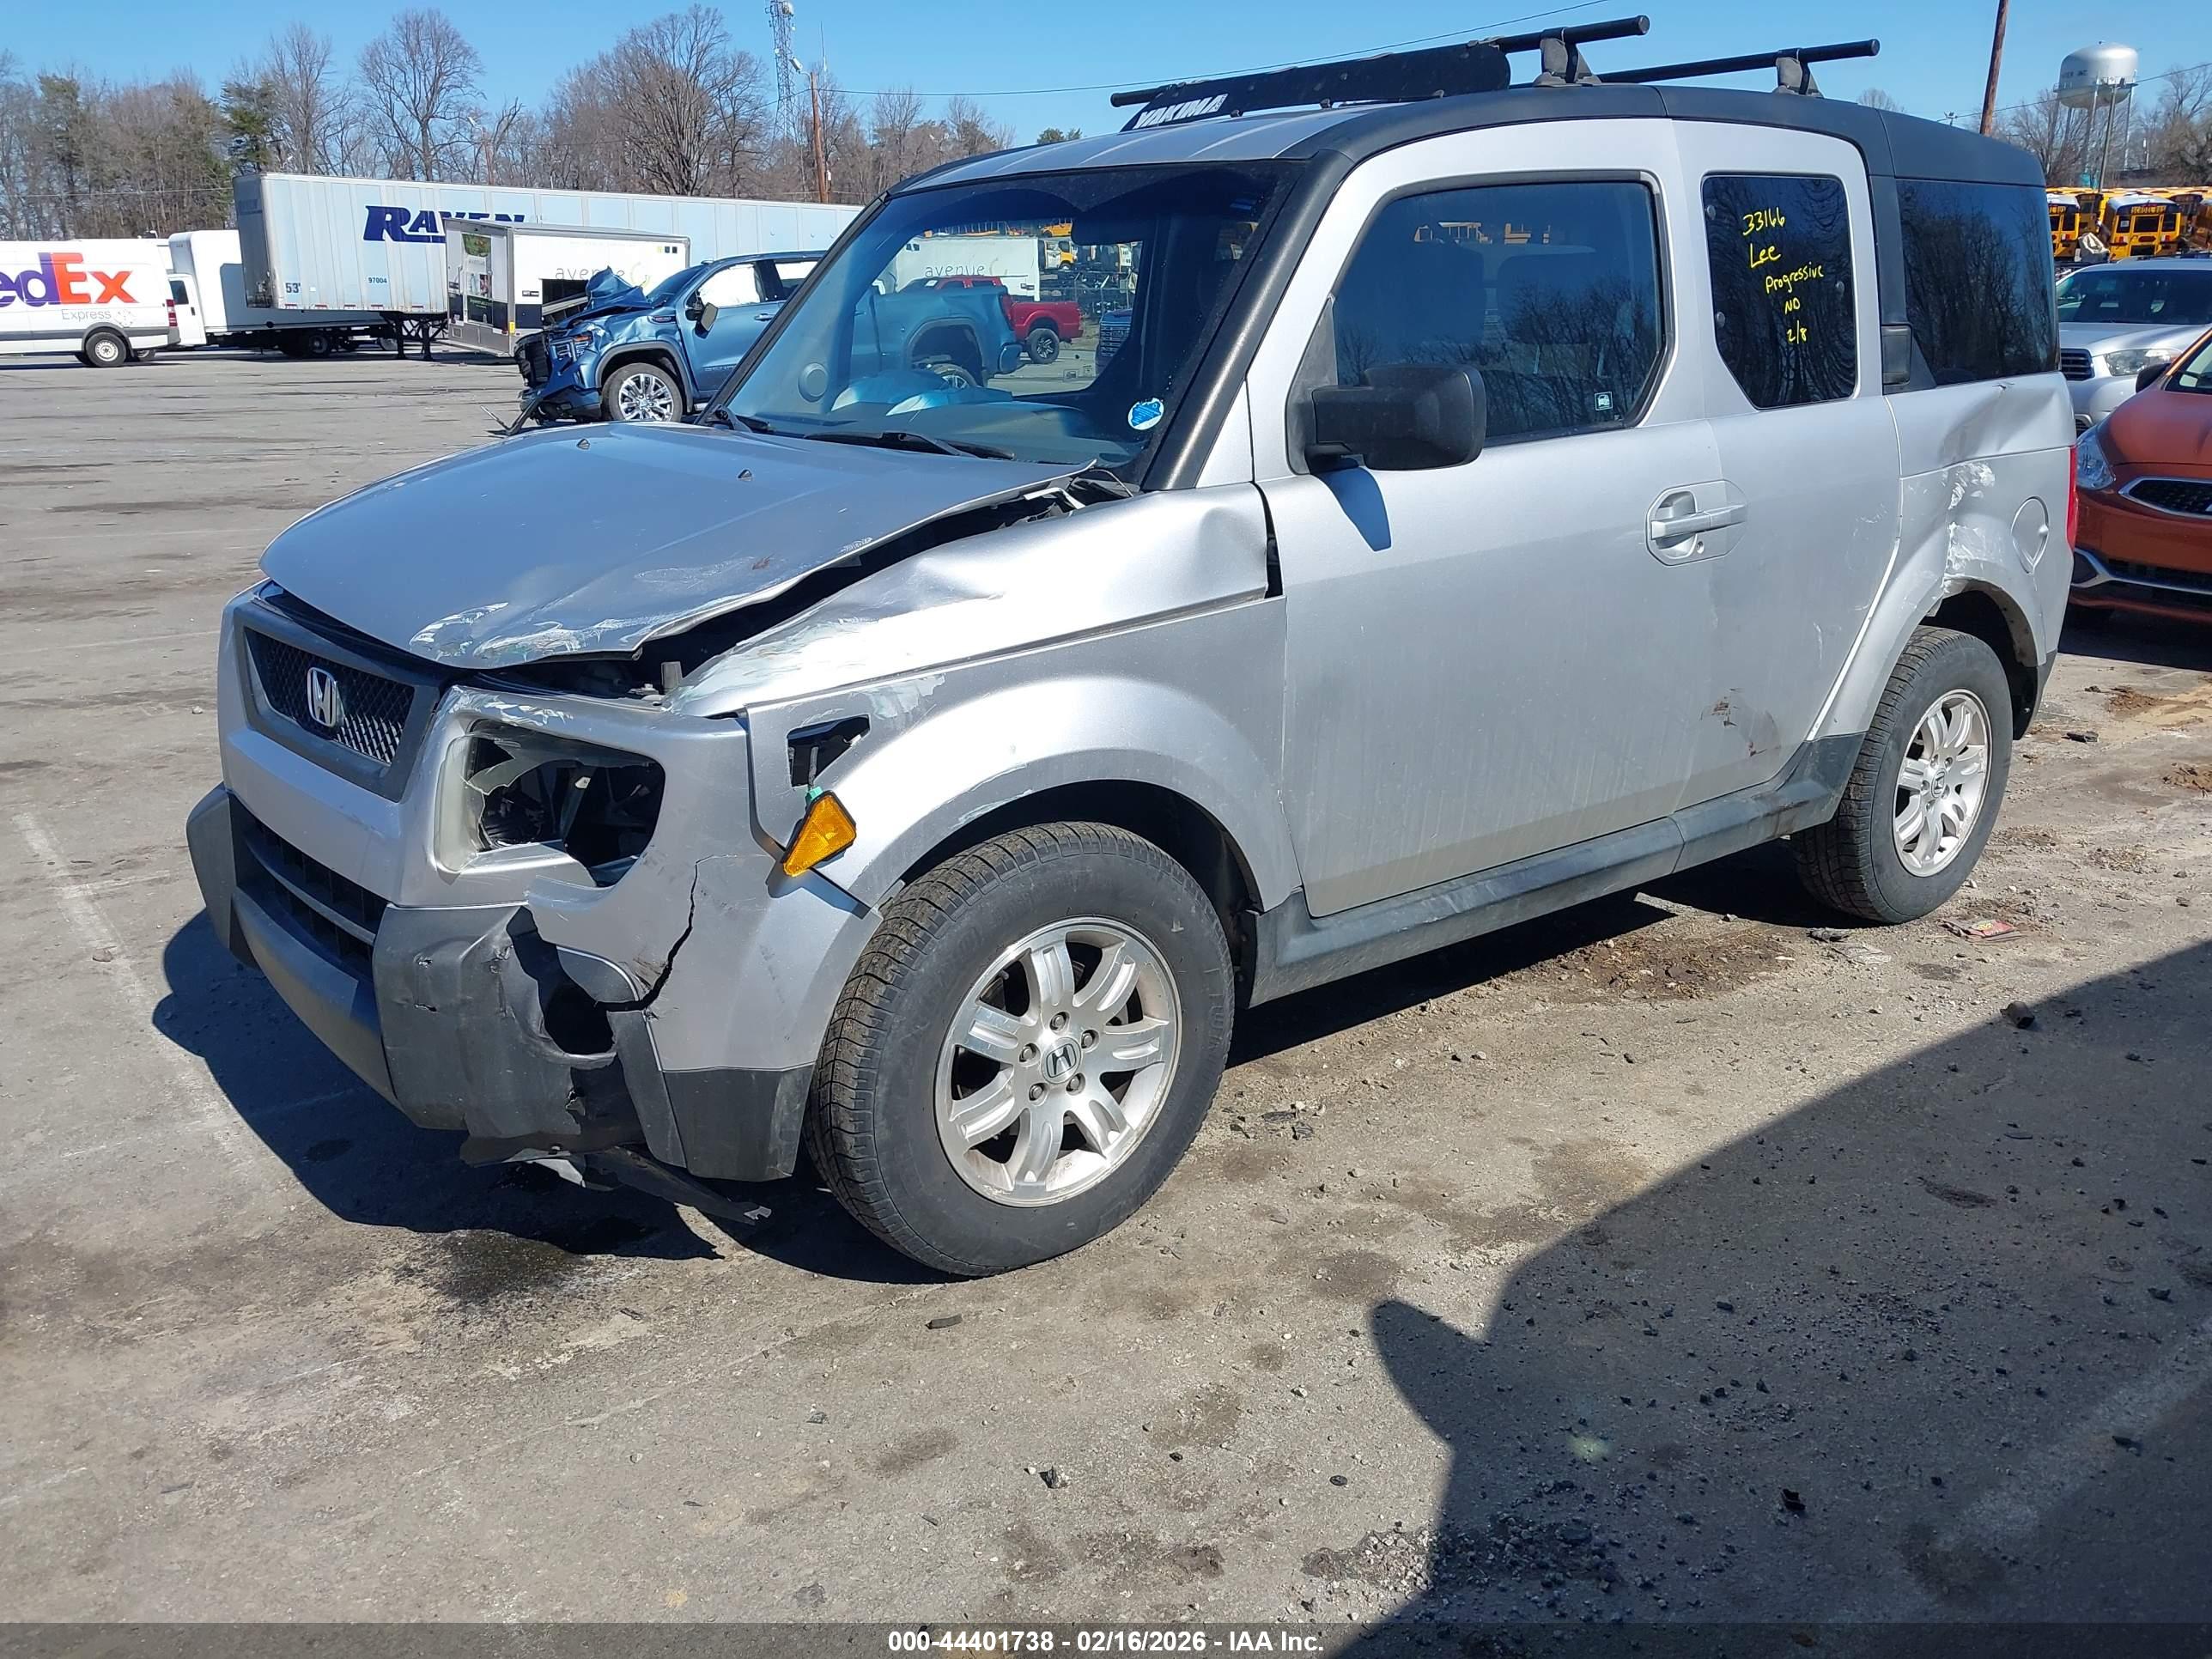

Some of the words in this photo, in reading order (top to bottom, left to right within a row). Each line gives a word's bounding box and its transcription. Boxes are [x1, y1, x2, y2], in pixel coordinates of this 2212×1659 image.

[1132, 93, 1229, 129] YAKIMA
[1742, 207, 1786, 236] 33166
[1749, 243, 1782, 269] Lee
[0, 252, 139, 307] edEx
[1765, 261, 1824, 294] Progressive
[61, 308, 112, 322] Express
